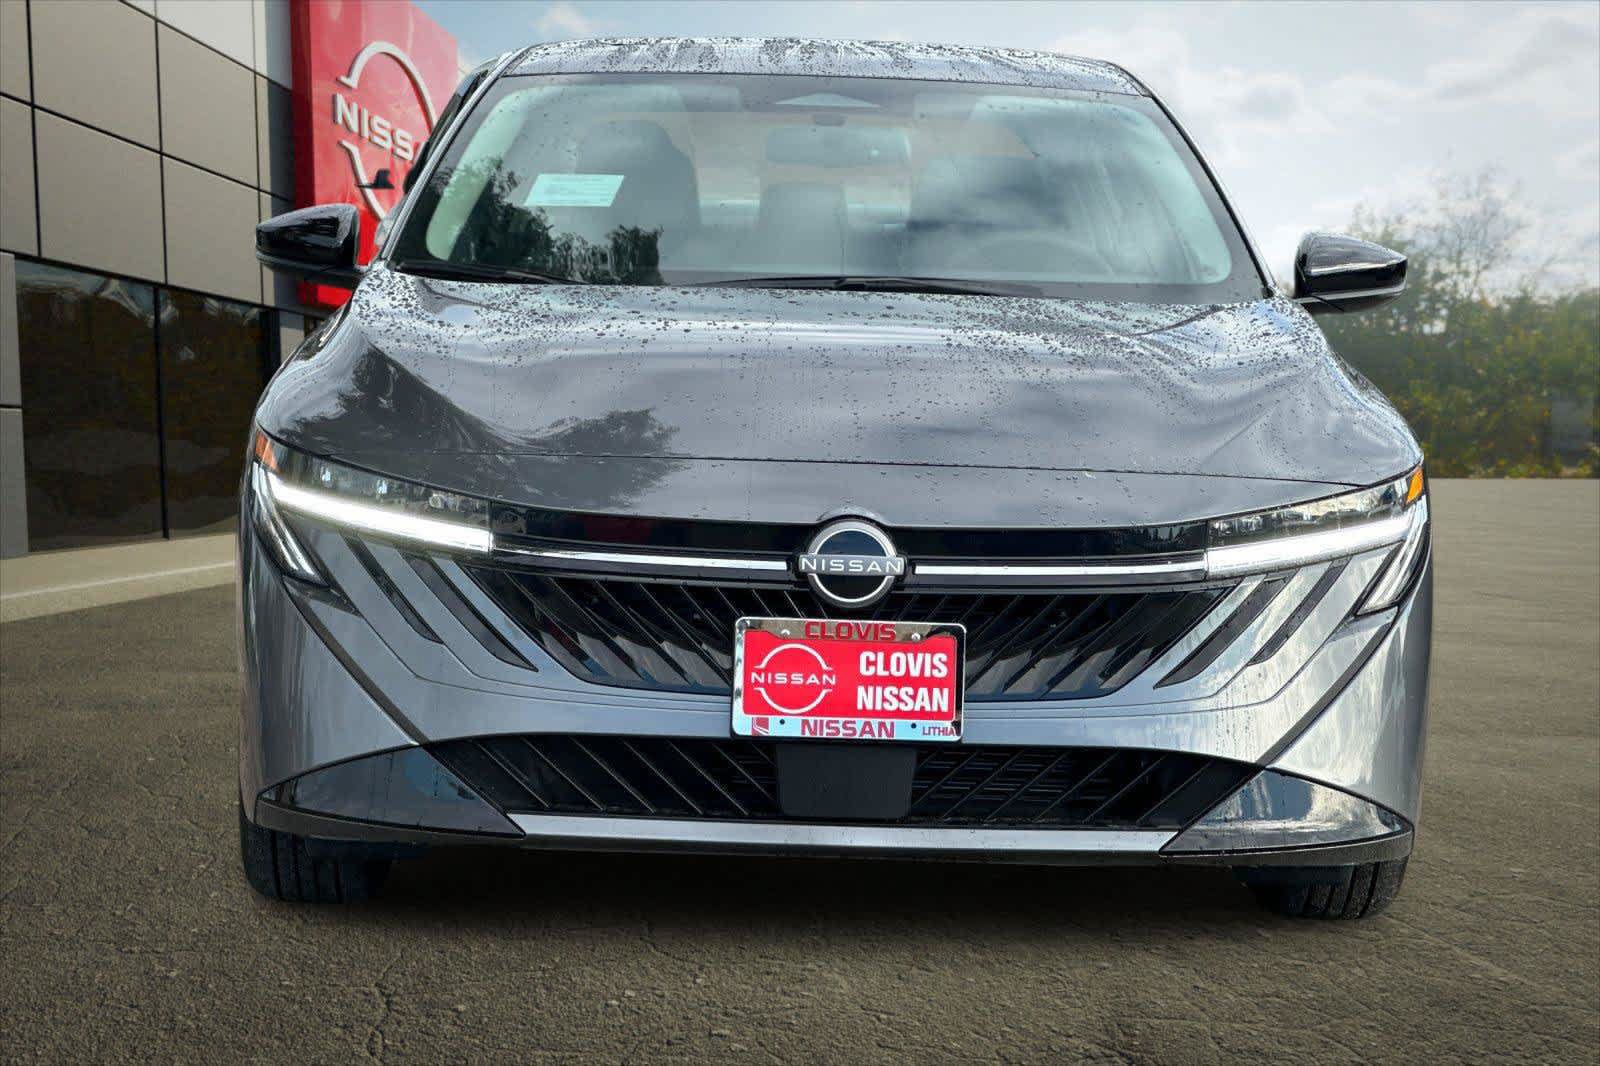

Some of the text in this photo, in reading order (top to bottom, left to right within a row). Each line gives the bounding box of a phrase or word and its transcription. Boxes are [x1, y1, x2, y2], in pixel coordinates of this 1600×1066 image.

[801, 557, 901, 573] NISSAN
[804, 621, 896, 641] CLOVIS
[859, 651, 948, 678] CLOVIS
[751, 672, 836, 686] NISSAN
[857, 685, 949, 712] NISSAN
[800, 719, 895, 738] NISSAN
